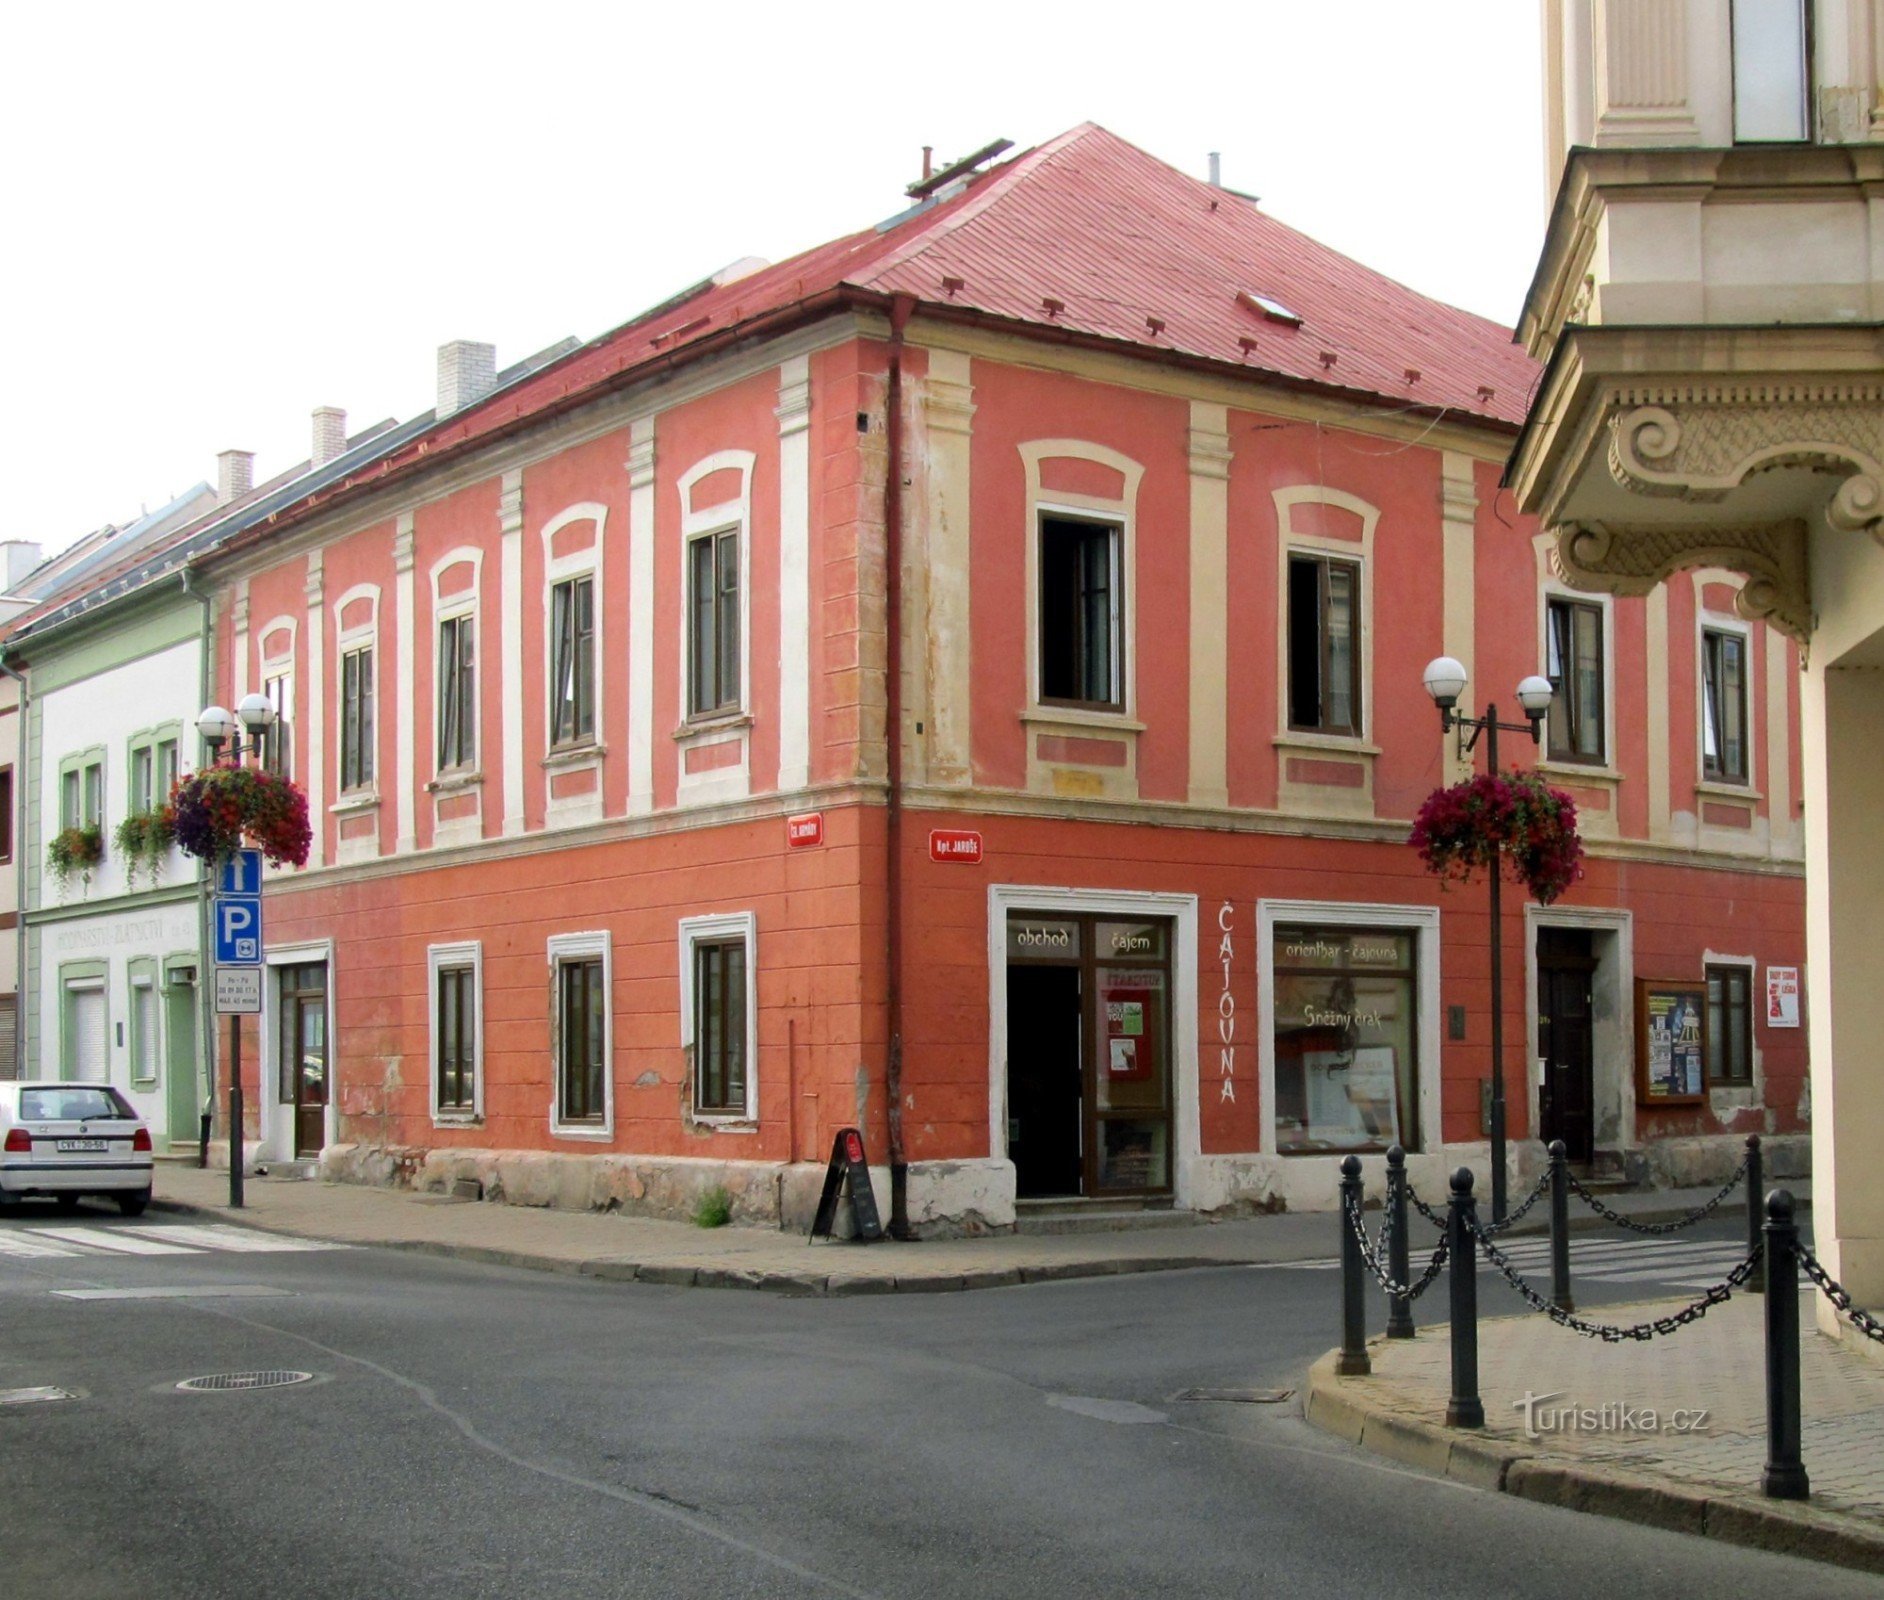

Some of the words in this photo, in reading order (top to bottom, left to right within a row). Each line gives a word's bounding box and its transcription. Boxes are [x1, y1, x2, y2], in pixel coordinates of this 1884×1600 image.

[953, 838, 978, 853] JAROŠE
[224, 906, 251, 943] P
[1018, 927, 1069, 947] obchod
[1111, 932, 1150, 952] čajem
[1286, 941, 1340, 958] orientbar
[1218, 900, 1236, 1104] ČAJOVNA
[1304, 1005, 1351, 1032] Sněžný
[1354, 1008, 1383, 1031] drak
